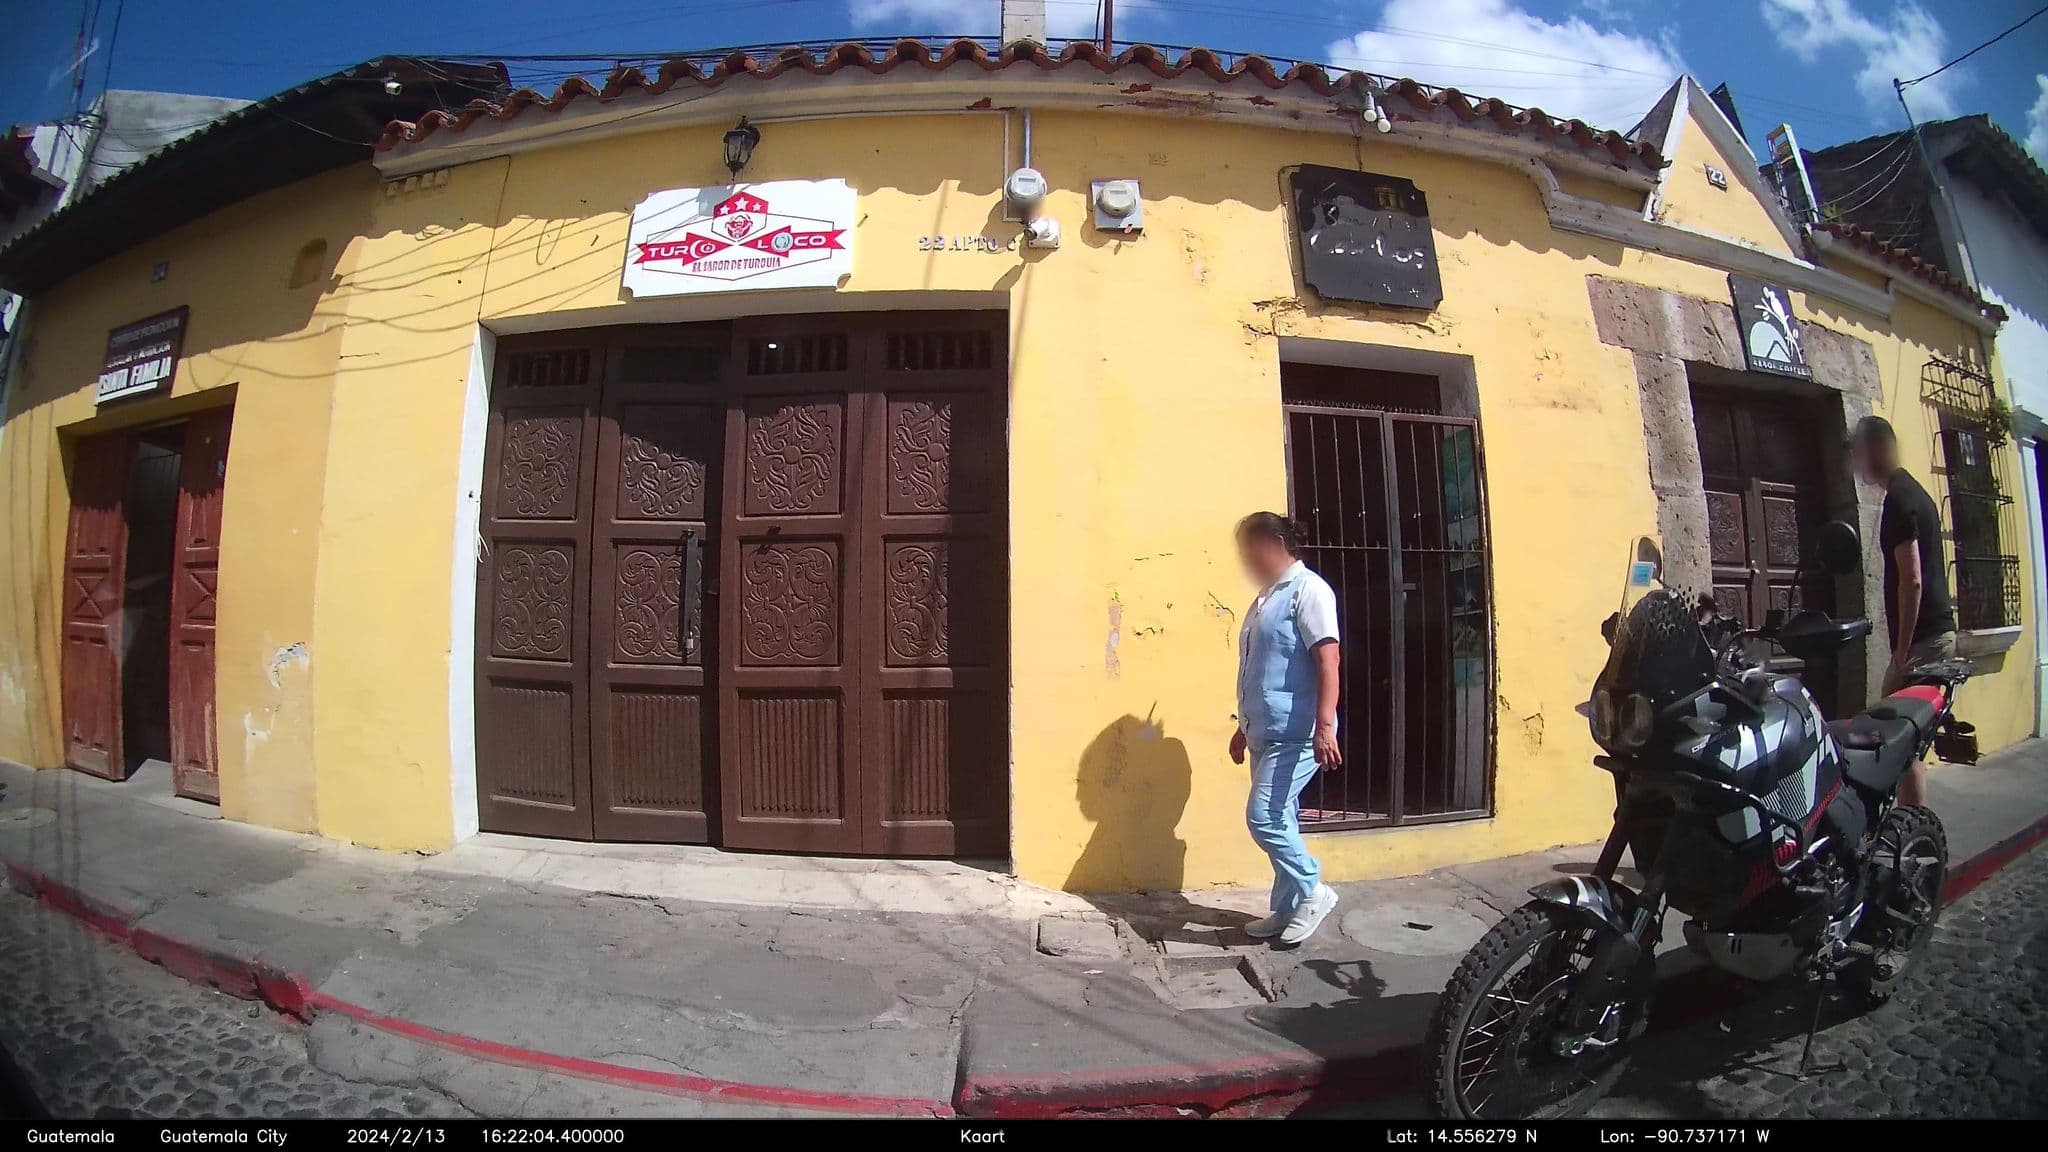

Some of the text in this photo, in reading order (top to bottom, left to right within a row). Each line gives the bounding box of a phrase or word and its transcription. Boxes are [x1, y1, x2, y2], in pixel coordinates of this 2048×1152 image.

[1708, 166, 1726, 185] 22
[649, 232, 827, 259] TURCO LOCO
[919, 236, 945, 250] 22
[129, 356, 172, 386] FAMILIA
